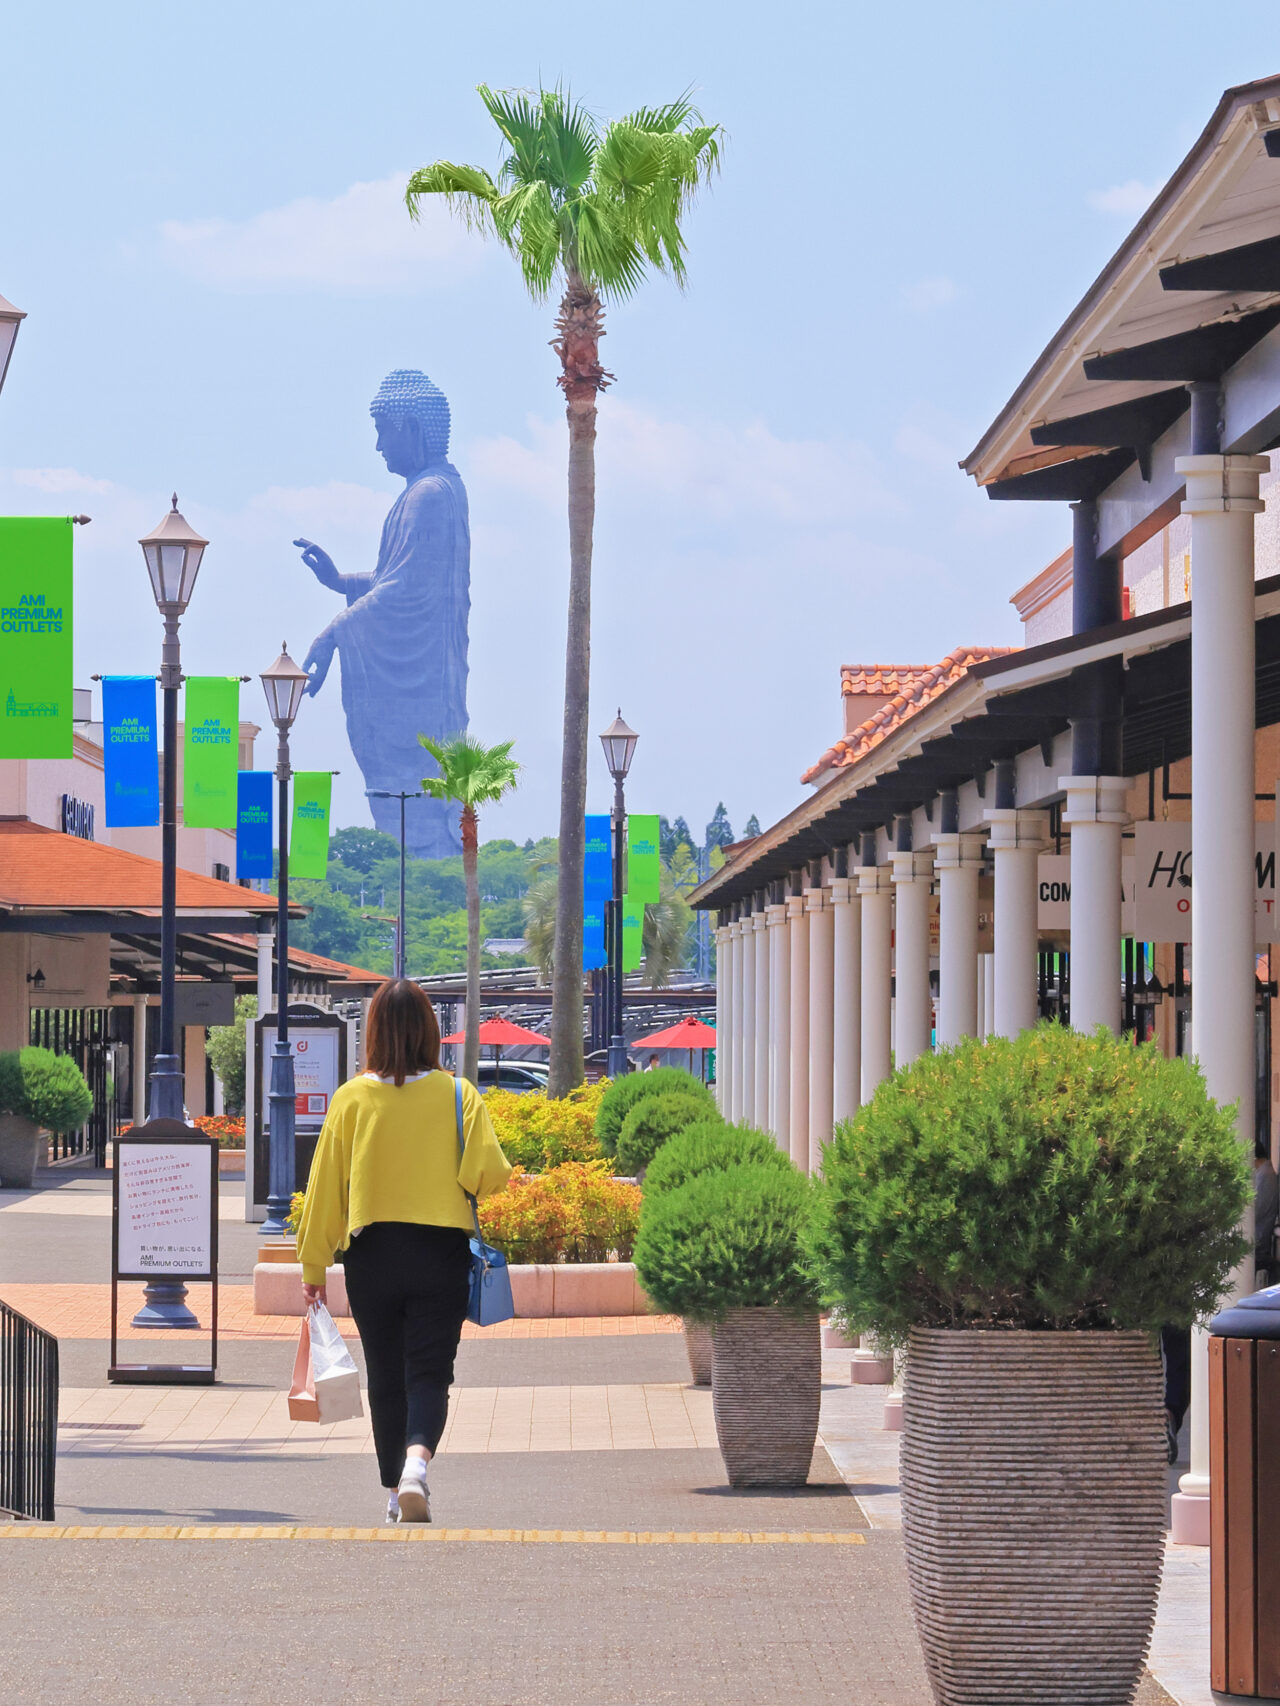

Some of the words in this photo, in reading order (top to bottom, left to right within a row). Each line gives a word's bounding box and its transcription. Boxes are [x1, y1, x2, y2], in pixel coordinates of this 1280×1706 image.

[19, 594, 46, 607] AMI
[1, 607, 63, 620] PREMIUM
[1, 620, 64, 633] OUTLETS
[122, 718, 139, 726] AMI
[203, 718, 220, 726] AMI
[110, 726, 150, 735] PREMIUM
[191, 727, 231, 735] PREMIUM
[110, 734, 150, 743] OUTLETS
[191, 735, 231, 744] OUTLETS
